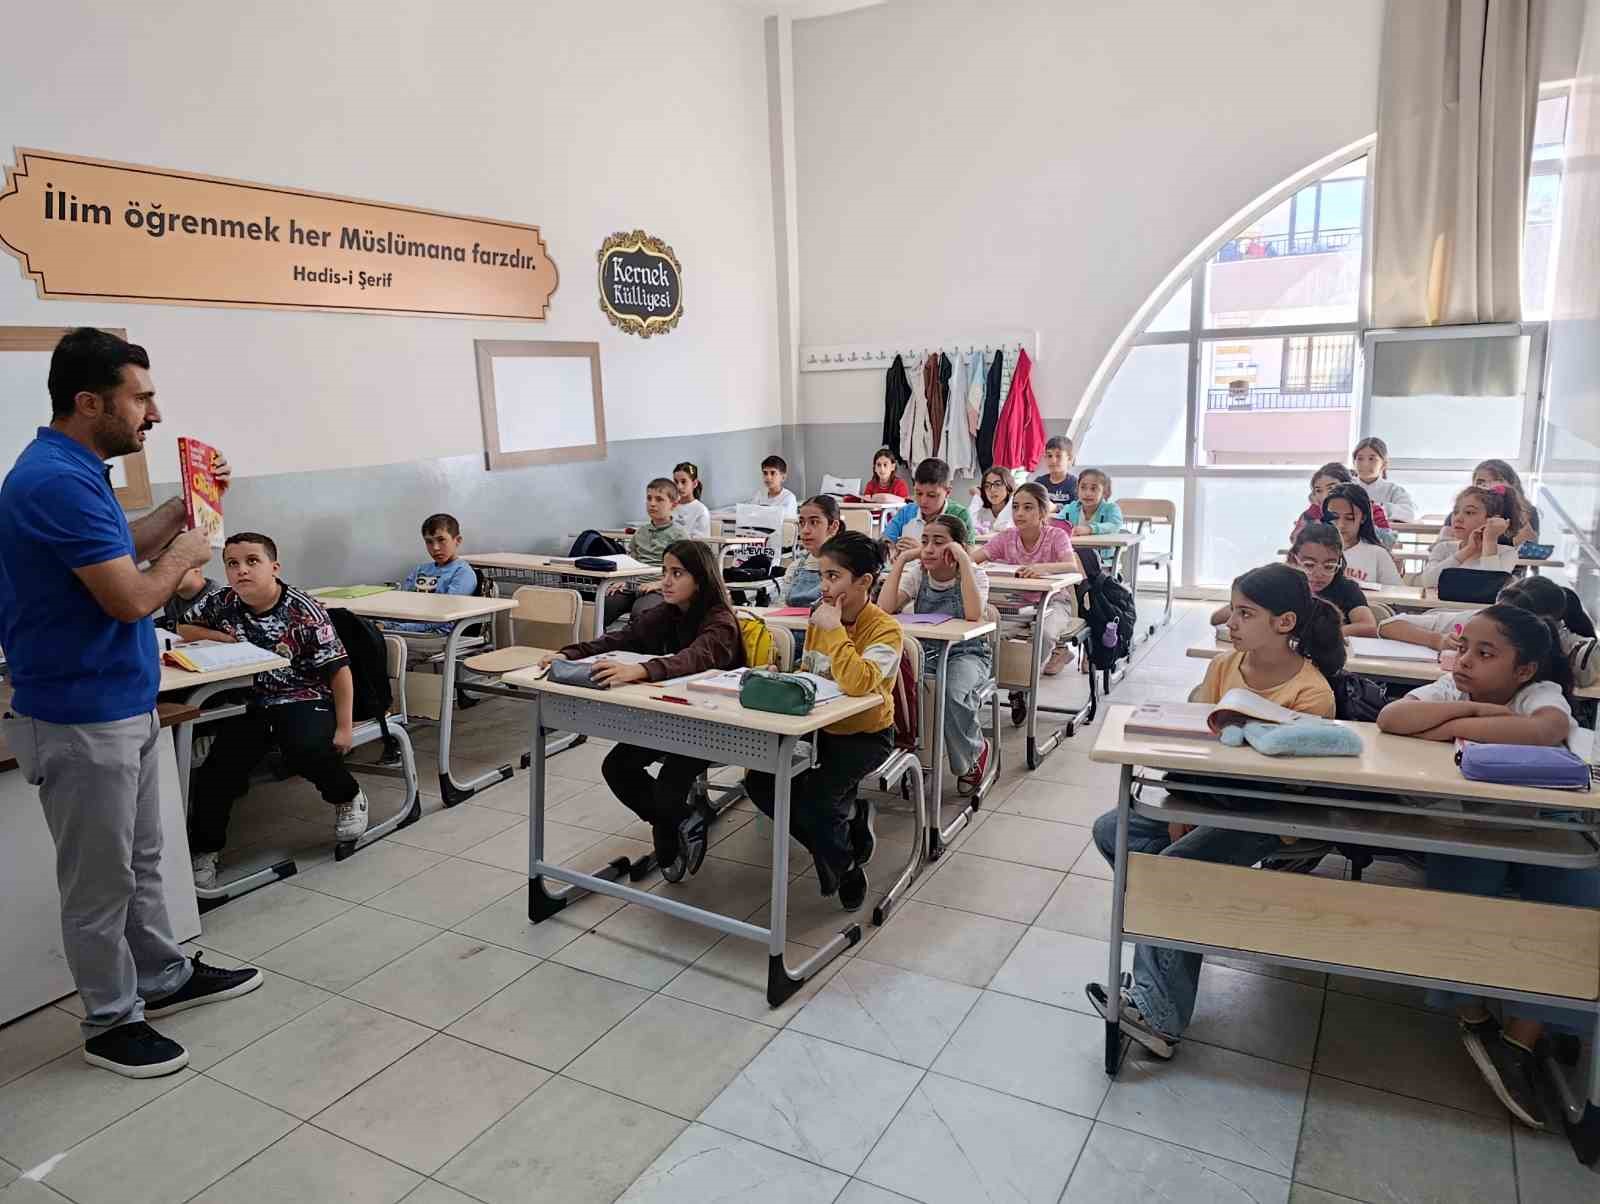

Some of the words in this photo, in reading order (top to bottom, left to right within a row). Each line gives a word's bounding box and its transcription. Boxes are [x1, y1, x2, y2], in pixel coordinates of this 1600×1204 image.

[44, 182, 112, 225] İlim
[124, 200, 281, 242] öğrenmek
[289, 219, 332, 248] her
[339, 226, 466, 263] Müslümana
[471, 242, 537, 271] farzdır.
[293, 265, 353, 286] Hadis-i
[357, 270, 393, 290] Şerif
[612, 256, 670, 287] Kernek
[613, 284, 671, 312] Külliyesi
